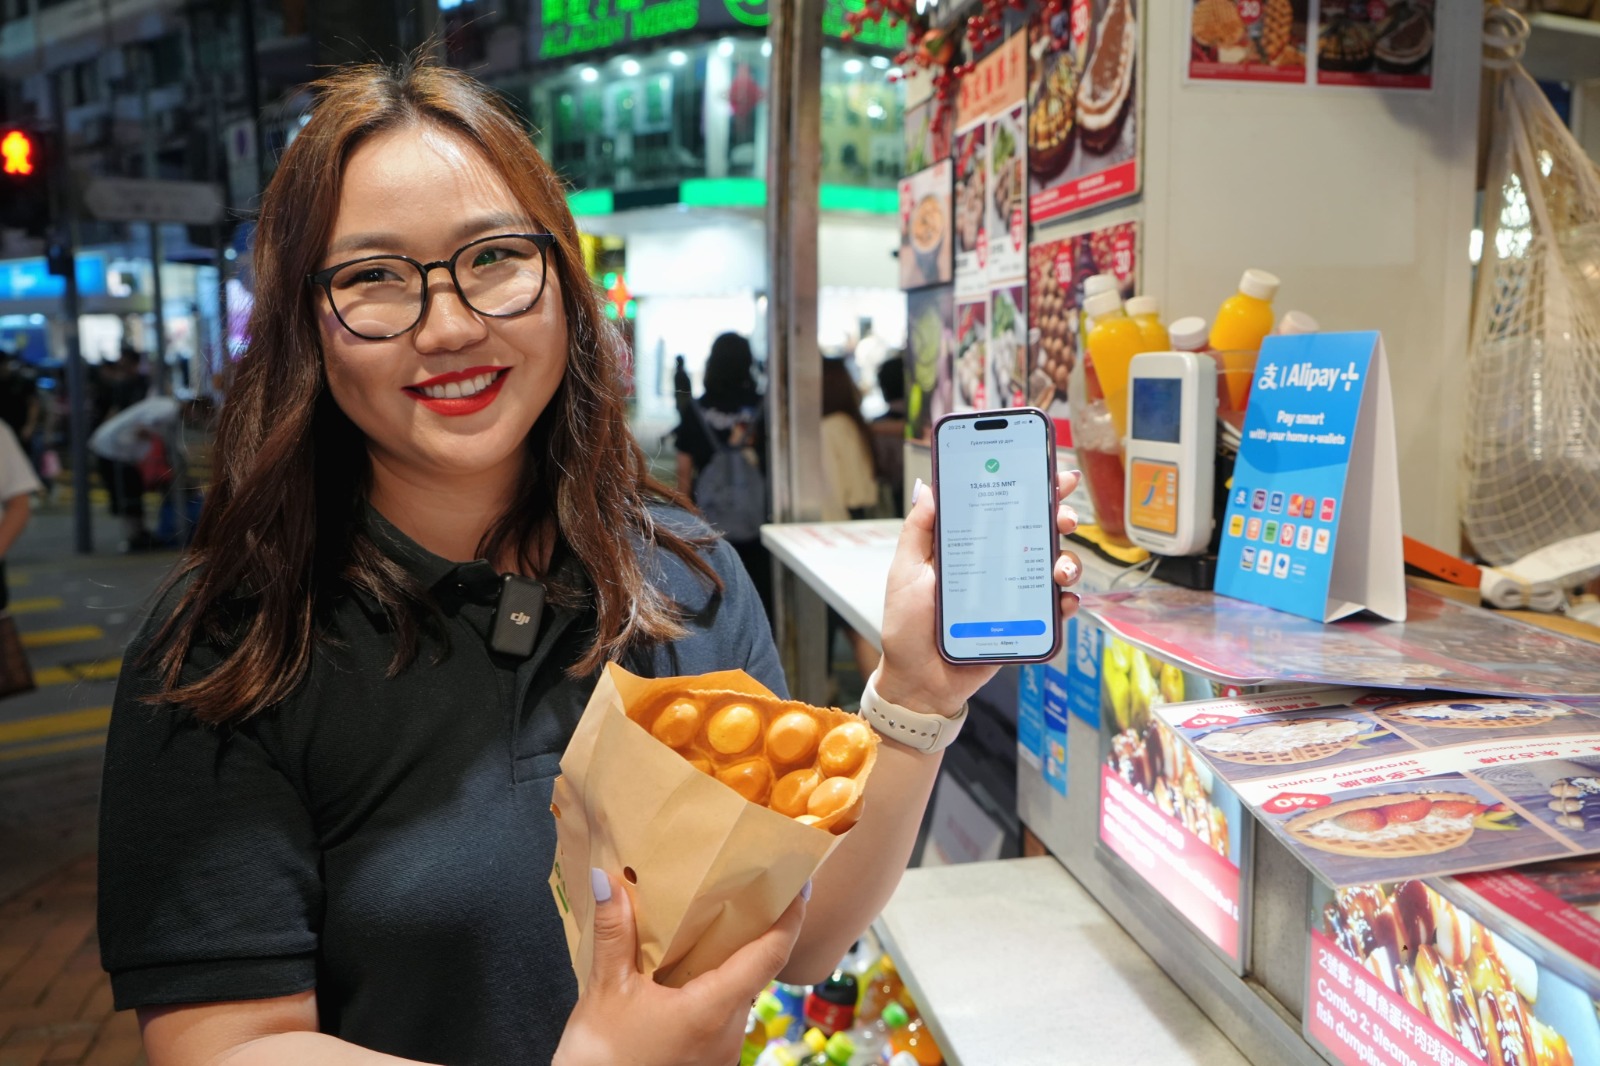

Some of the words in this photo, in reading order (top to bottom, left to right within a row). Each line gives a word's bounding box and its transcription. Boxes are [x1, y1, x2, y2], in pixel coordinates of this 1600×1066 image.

[1276, 410, 1295, 427] Pay
[1296, 412, 1325, 425] smart
[1249, 428, 1267, 439] with
[1267, 430, 1286, 443] your
[1286, 429, 1308, 443] home
[1309, 432, 1346, 445] e-wallets
[1001, 480, 1016, 488] MNT
[1332, 759, 1419, 779] Strawberry
[1267, 777, 1327, 790] Crunch
[1317, 978, 1358, 1024] Combo
[1316, 1001, 1334, 1030] fish
